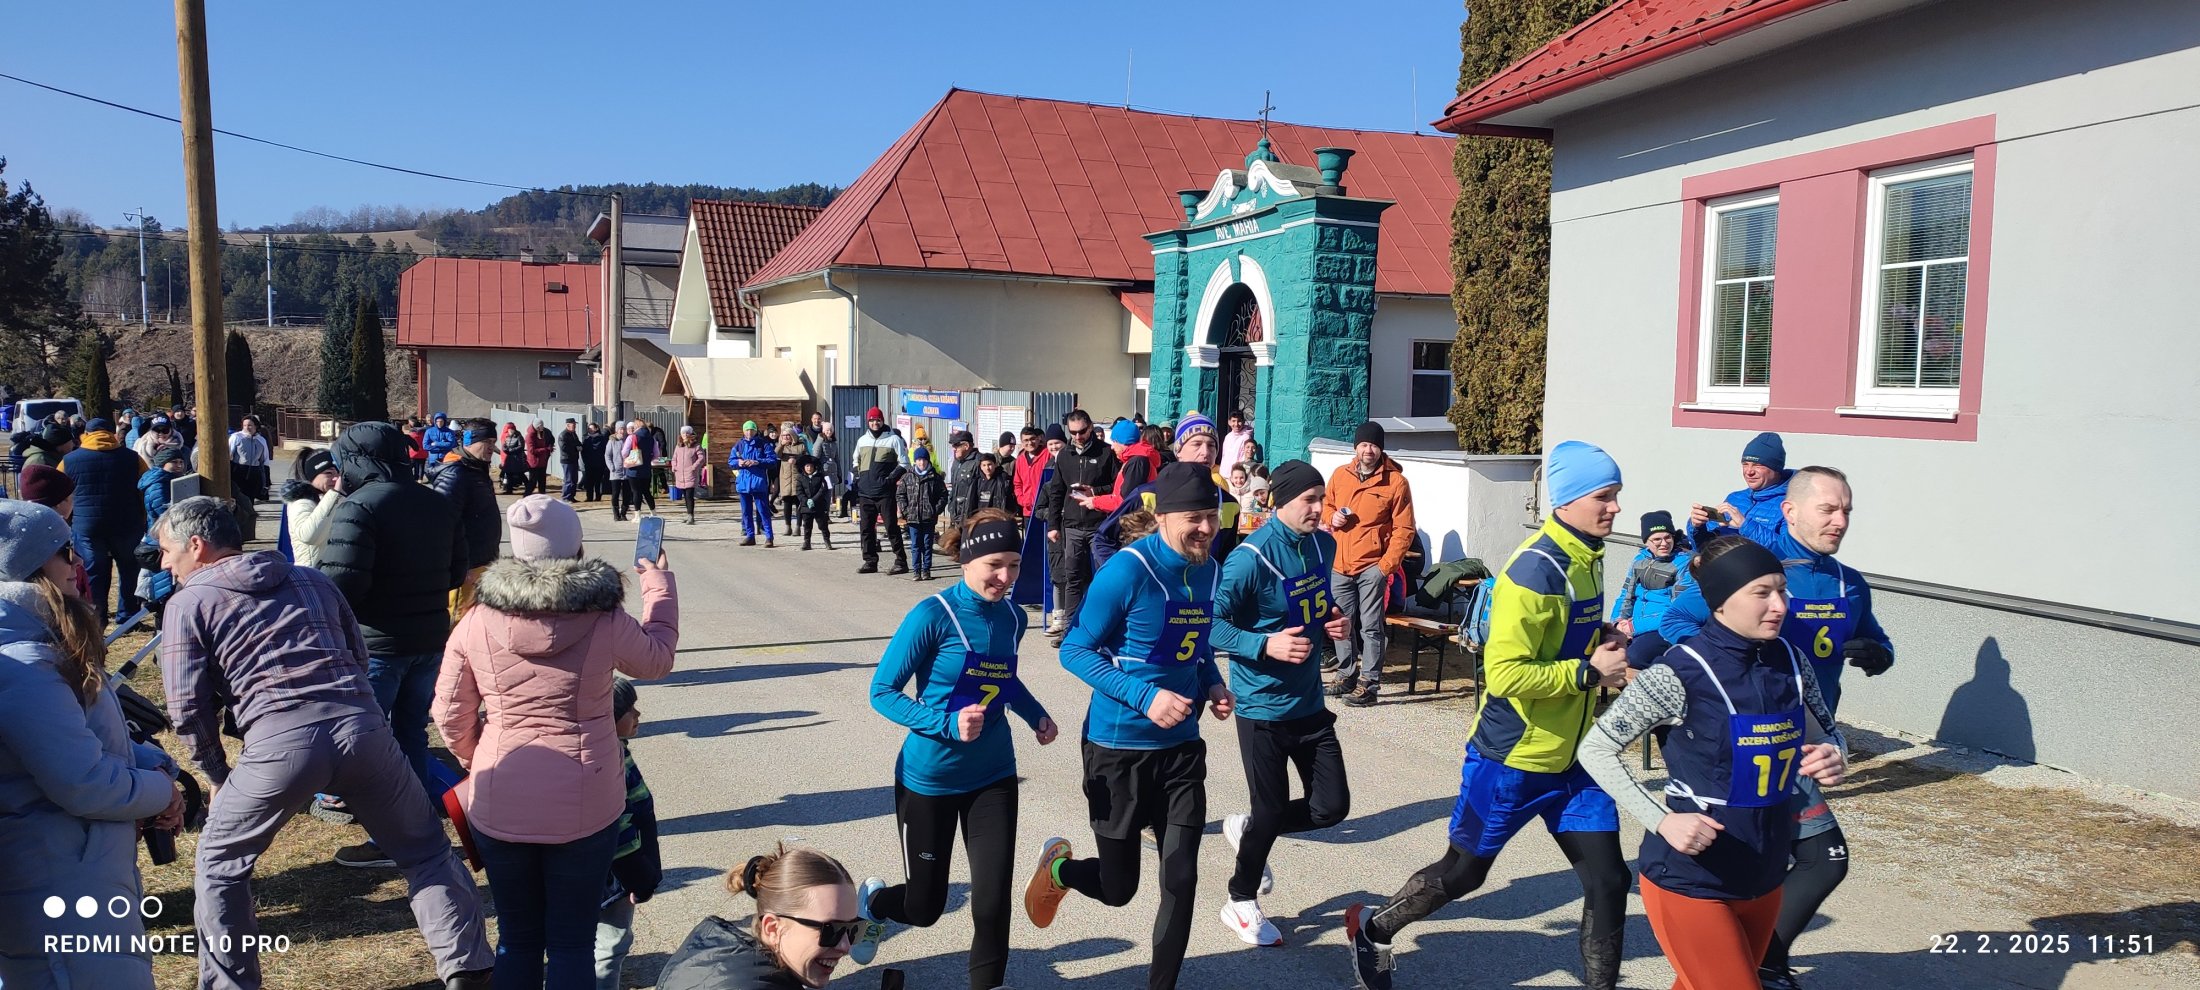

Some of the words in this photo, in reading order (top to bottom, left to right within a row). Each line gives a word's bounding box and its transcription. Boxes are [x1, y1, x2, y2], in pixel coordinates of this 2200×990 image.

[1215, 224, 1232, 240] AVE
[1232, 217, 1259, 237] MARIA
[1299, 590, 1328, 625] 15
[1176, 631, 1200, 661] 5
[1813, 625, 1834, 658] 6
[980, 684, 1000, 706] 7
[1752, 719, 1794, 733] MEMORIÁL
[1737, 736, 1770, 746] JOZEFA
[1752, 747, 1797, 797] 17
